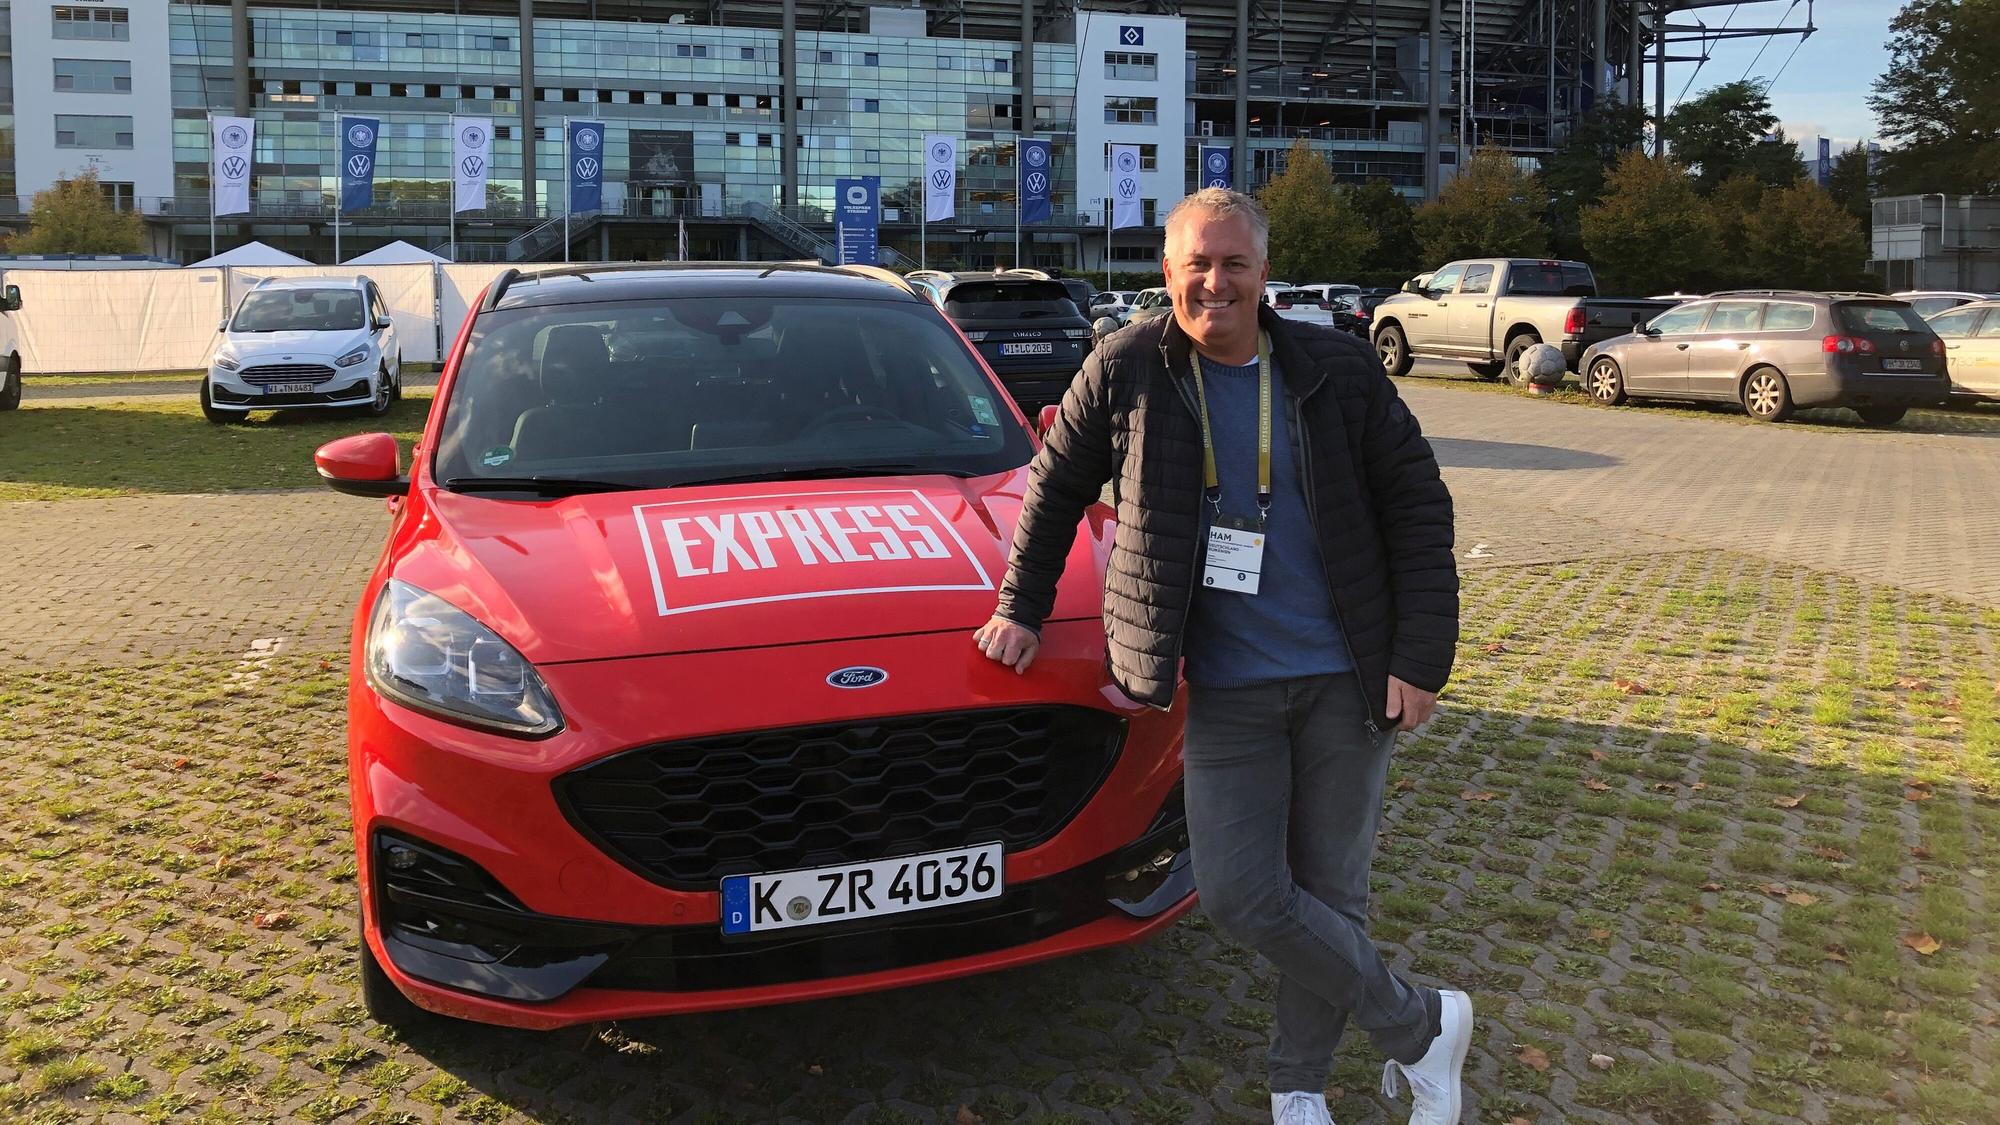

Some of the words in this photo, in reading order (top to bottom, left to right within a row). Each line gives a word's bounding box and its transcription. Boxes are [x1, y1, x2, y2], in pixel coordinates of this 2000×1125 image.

[661, 505, 952, 578] EXPRESS
[1210, 531, 1232, 542] HAM
[840, 670, 874, 684] Ford
[754, 880, 783, 924] K
[817, 869, 876, 917] ZR
[888, 852, 996, 905] 4036
[732, 911, 742, 925] D
